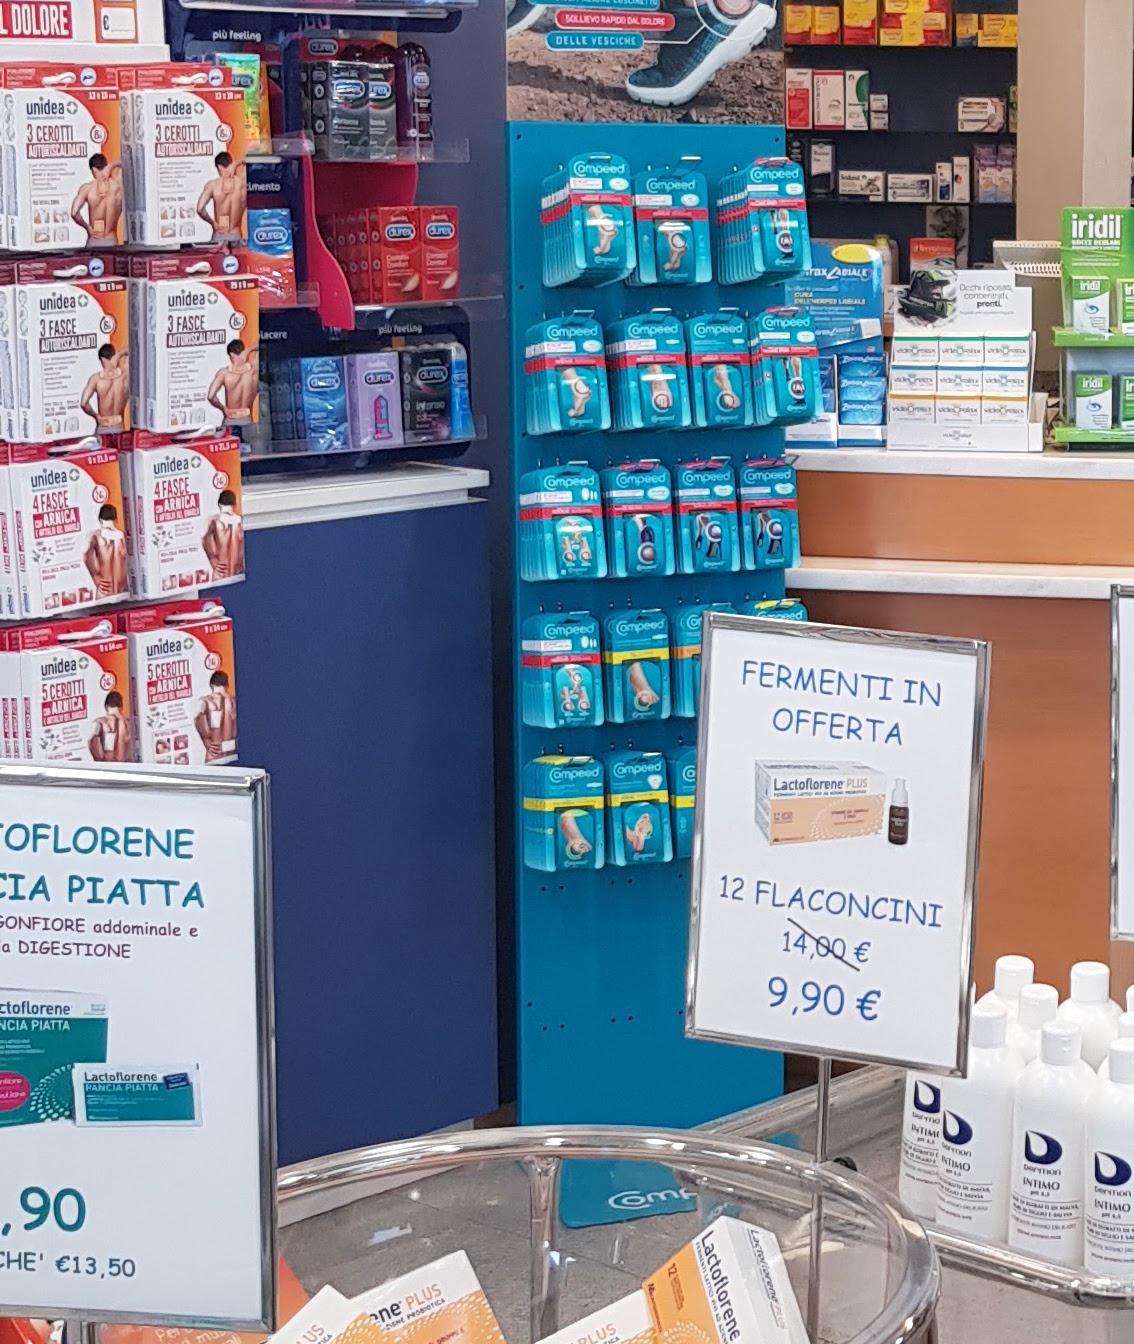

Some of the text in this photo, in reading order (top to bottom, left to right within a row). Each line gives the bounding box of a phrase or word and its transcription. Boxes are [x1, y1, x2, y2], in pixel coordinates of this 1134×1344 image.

[11, 3, 70, 36] DOLORE
[565, 14, 600, 25] SOLLIEVO
[601, 15, 626, 25] RAPIDO
[626, 16, 641, 26] DAL
[229, 30, 261, 42] feeling
[556, 35, 637, 47] DELLE VESCICHE
[26, 97, 65, 115] unidea
[155, 98, 192, 115] unidea
[27, 124, 73, 142] 3 CEROTTI
[155, 124, 199, 141] 3 CEROTTI
[573, 160, 625, 177] Compeed
[750, 166, 799, 184] Compeed
[646, 177, 696, 194] Compeed
[1072, 213, 1121, 239] iridil
[40, 292, 76, 310] unidea
[168, 290, 205, 307] unidea
[49, 318, 77, 336] FASCE
[176, 315, 205, 332] FASCE
[546, 324, 598, 340] Compeed
[154, 456, 189, 475] unidea
[31, 468, 67, 488] unidea
[154, 477, 190, 498] 4 FASCE
[33, 490, 69, 513] 4 FASCE
[164, 494, 196, 512] ARNICA
[43, 509, 76, 528] ARNICA
[146, 638, 182, 657] unidea
[41, 658, 77, 677] unidea
[148, 660, 190, 680] 5 CEROTTI
[50, 679, 85, 699] CEROTTI
[156, 676, 188, 694] ARNICA
[742, 660, 942, 708] FERMENTI IN
[51, 697, 84, 716] ARNICA
[773, 708, 903, 746] OFFERTA
[773, 778, 844, 792] Lactoflorene
[0, 823, 194, 859] OFLORENE
[68, 875, 205, 908] PIATTA
[720, 875, 943, 929] 12 FLACONCINI
[93, 919, 182, 937] addominale
[189, 926, 198, 937] e
[18, 940, 131, 958] DIGESTIONE
[782, 931, 871, 963] 14,00 €
[768, 976, 882, 1022] 9,90 €
[31, 1019, 71, 1032] PIATTA
[84, 1071, 158, 1083] Lactoflorene
[85, 1083, 159, 1093] PANCIA PIATTA
[1023, 1176, 1060, 1192] INTIMO
[1094, 1199, 1131, 1213] INTIMO
[55, 1255, 136, 1279] €13,50
[701, 1230, 741, 1342] Lactoflorene
[405, 1283, 443, 1311] PLUS
